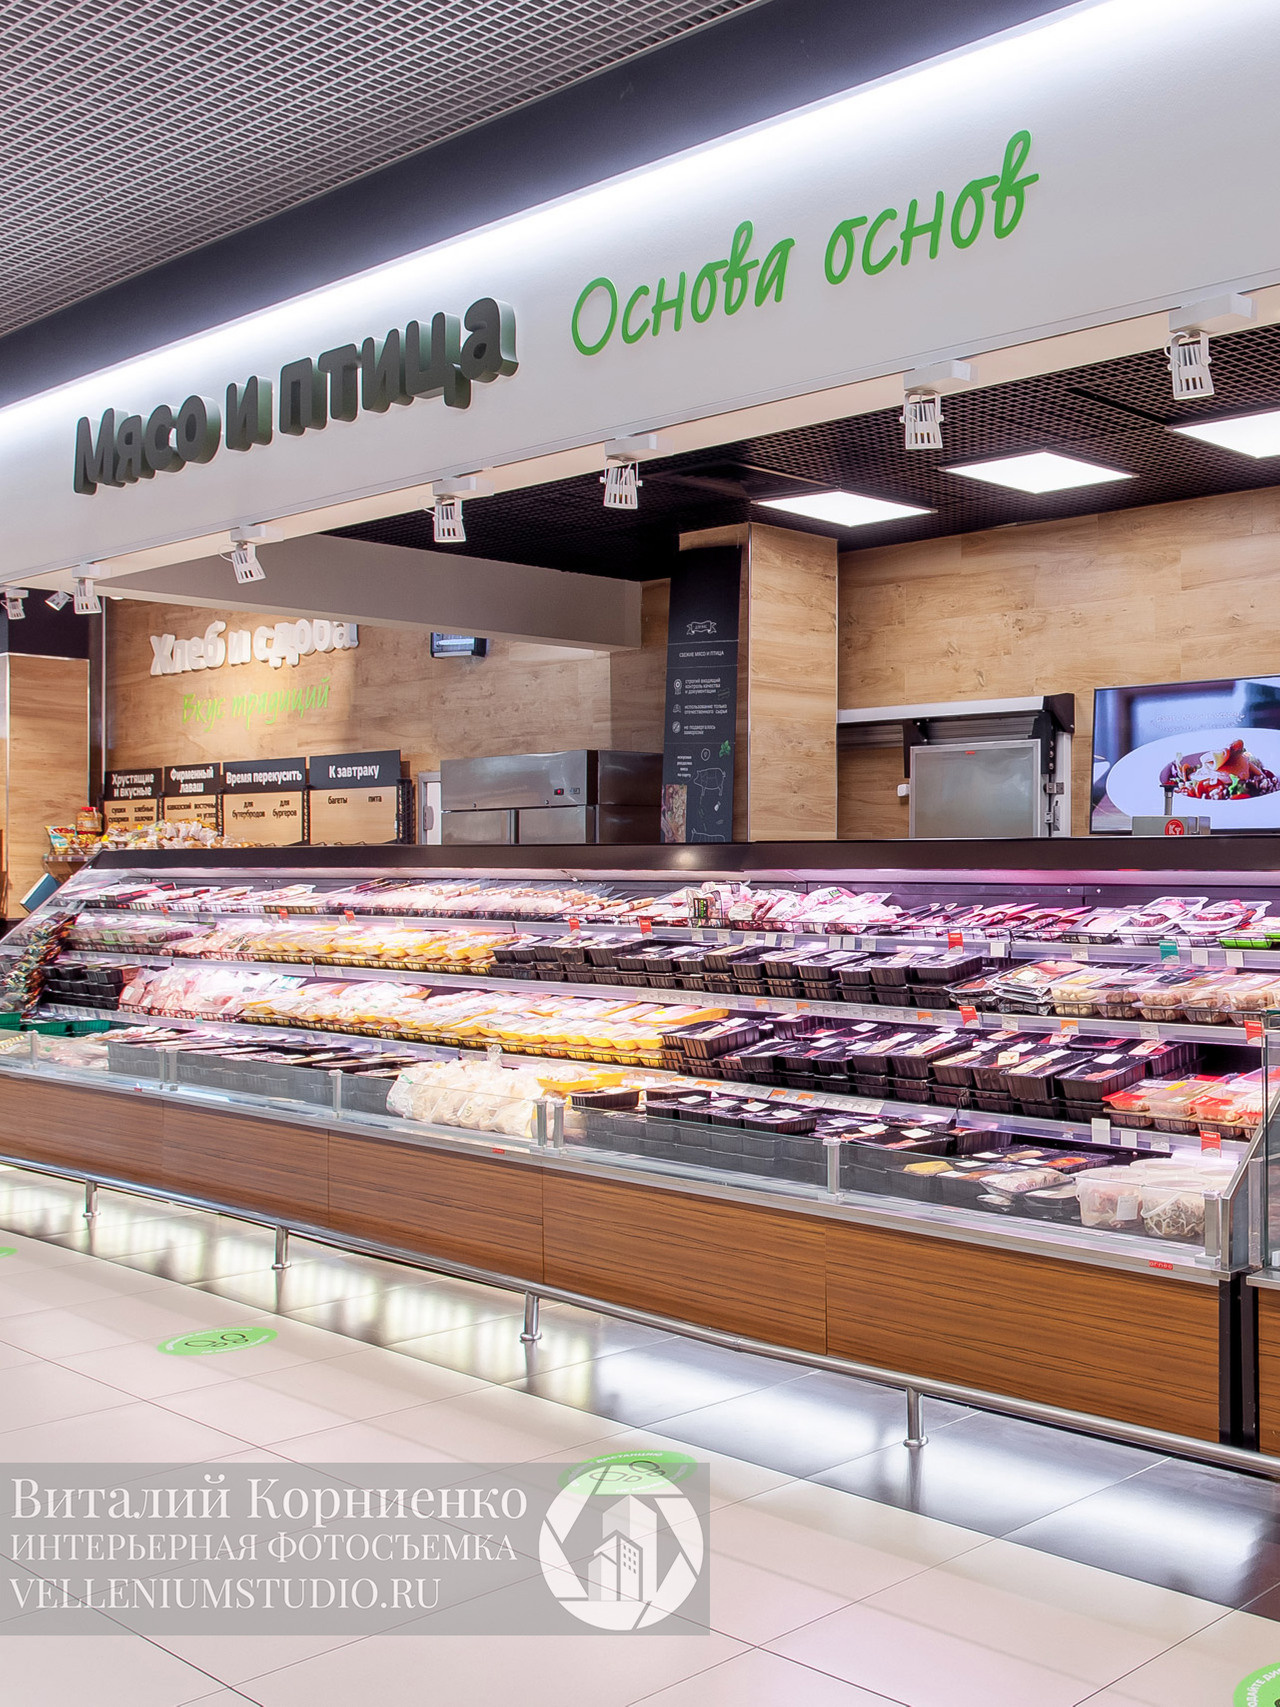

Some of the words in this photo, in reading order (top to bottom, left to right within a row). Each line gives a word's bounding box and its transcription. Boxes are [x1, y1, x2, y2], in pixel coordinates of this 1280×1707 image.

[571, 219, 796, 357] Основа
[823, 130, 1040, 286] основ
[73, 394, 221, 494] Мясо
[225, 374, 273, 452] и
[277, 297, 519, 436] птица
[150, 620, 226, 676] Хлеб
[228, 630, 251, 667] и
[182, 693, 226, 732] Вкус
[232, 676, 331, 729] традиций
[112, 774, 154, 787] Хрустящие
[170, 766, 214, 783] Фирменный
[226, 772, 251, 787] Время
[253, 770, 302, 786] перекусить
[329, 766, 336, 778] К
[337, 765, 380, 780] завтраку
[114, 788, 120, 797] и
[120, 786, 152, 799] вкусные
[180, 782, 204, 794] лаваш
[328, 795, 348, 805] багеты
